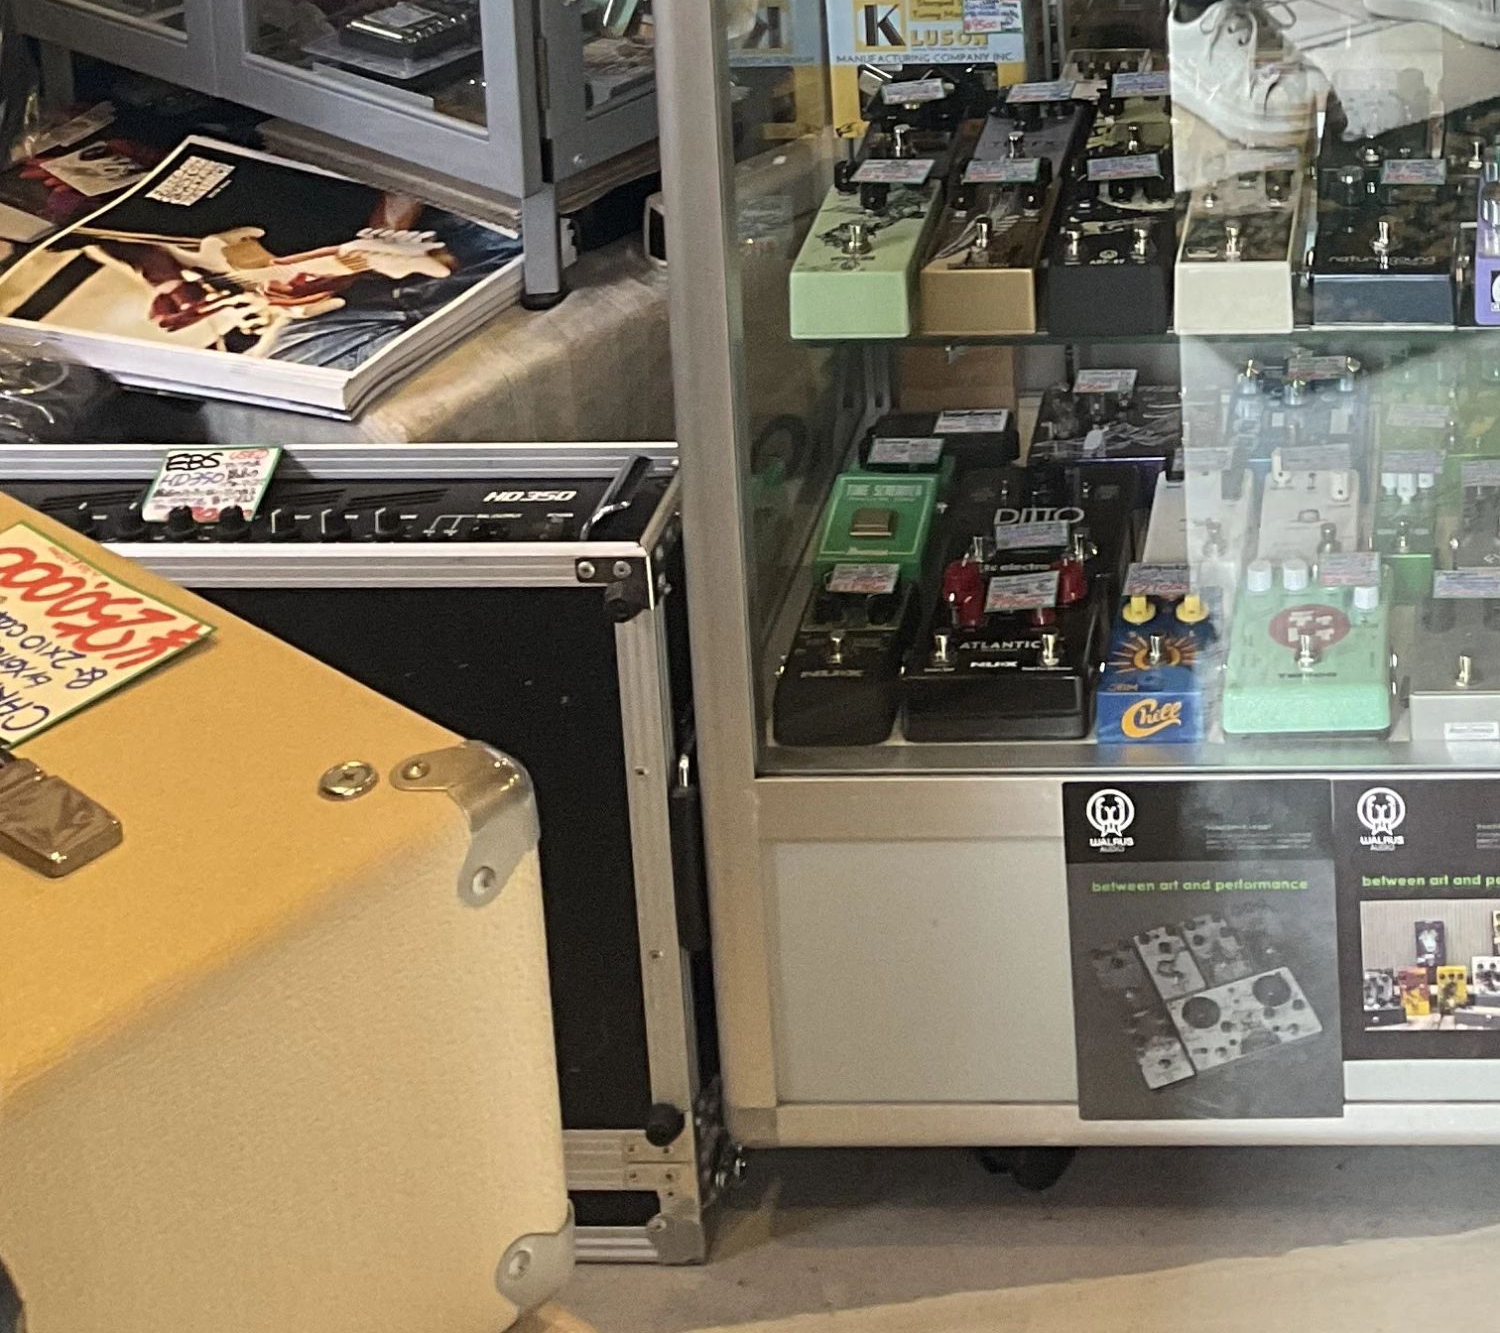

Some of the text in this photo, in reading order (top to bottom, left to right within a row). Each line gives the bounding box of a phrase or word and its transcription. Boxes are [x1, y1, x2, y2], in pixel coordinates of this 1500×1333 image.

[836, 52, 990, 63] MANUFACTURING COMPANY
[166, 452, 224, 472] EBS
[958, 639, 1041, 649] ATLANTIC
[1089, 836, 1134, 848] WALRUS
[1359, 834, 1405, 846] WALRUS
[1090, 878, 1309, 894] between art and performance
[1362, 874, 1427, 887] between
[1429, 874, 1449, 887] art
[1453, 874, 1481, 887] and
